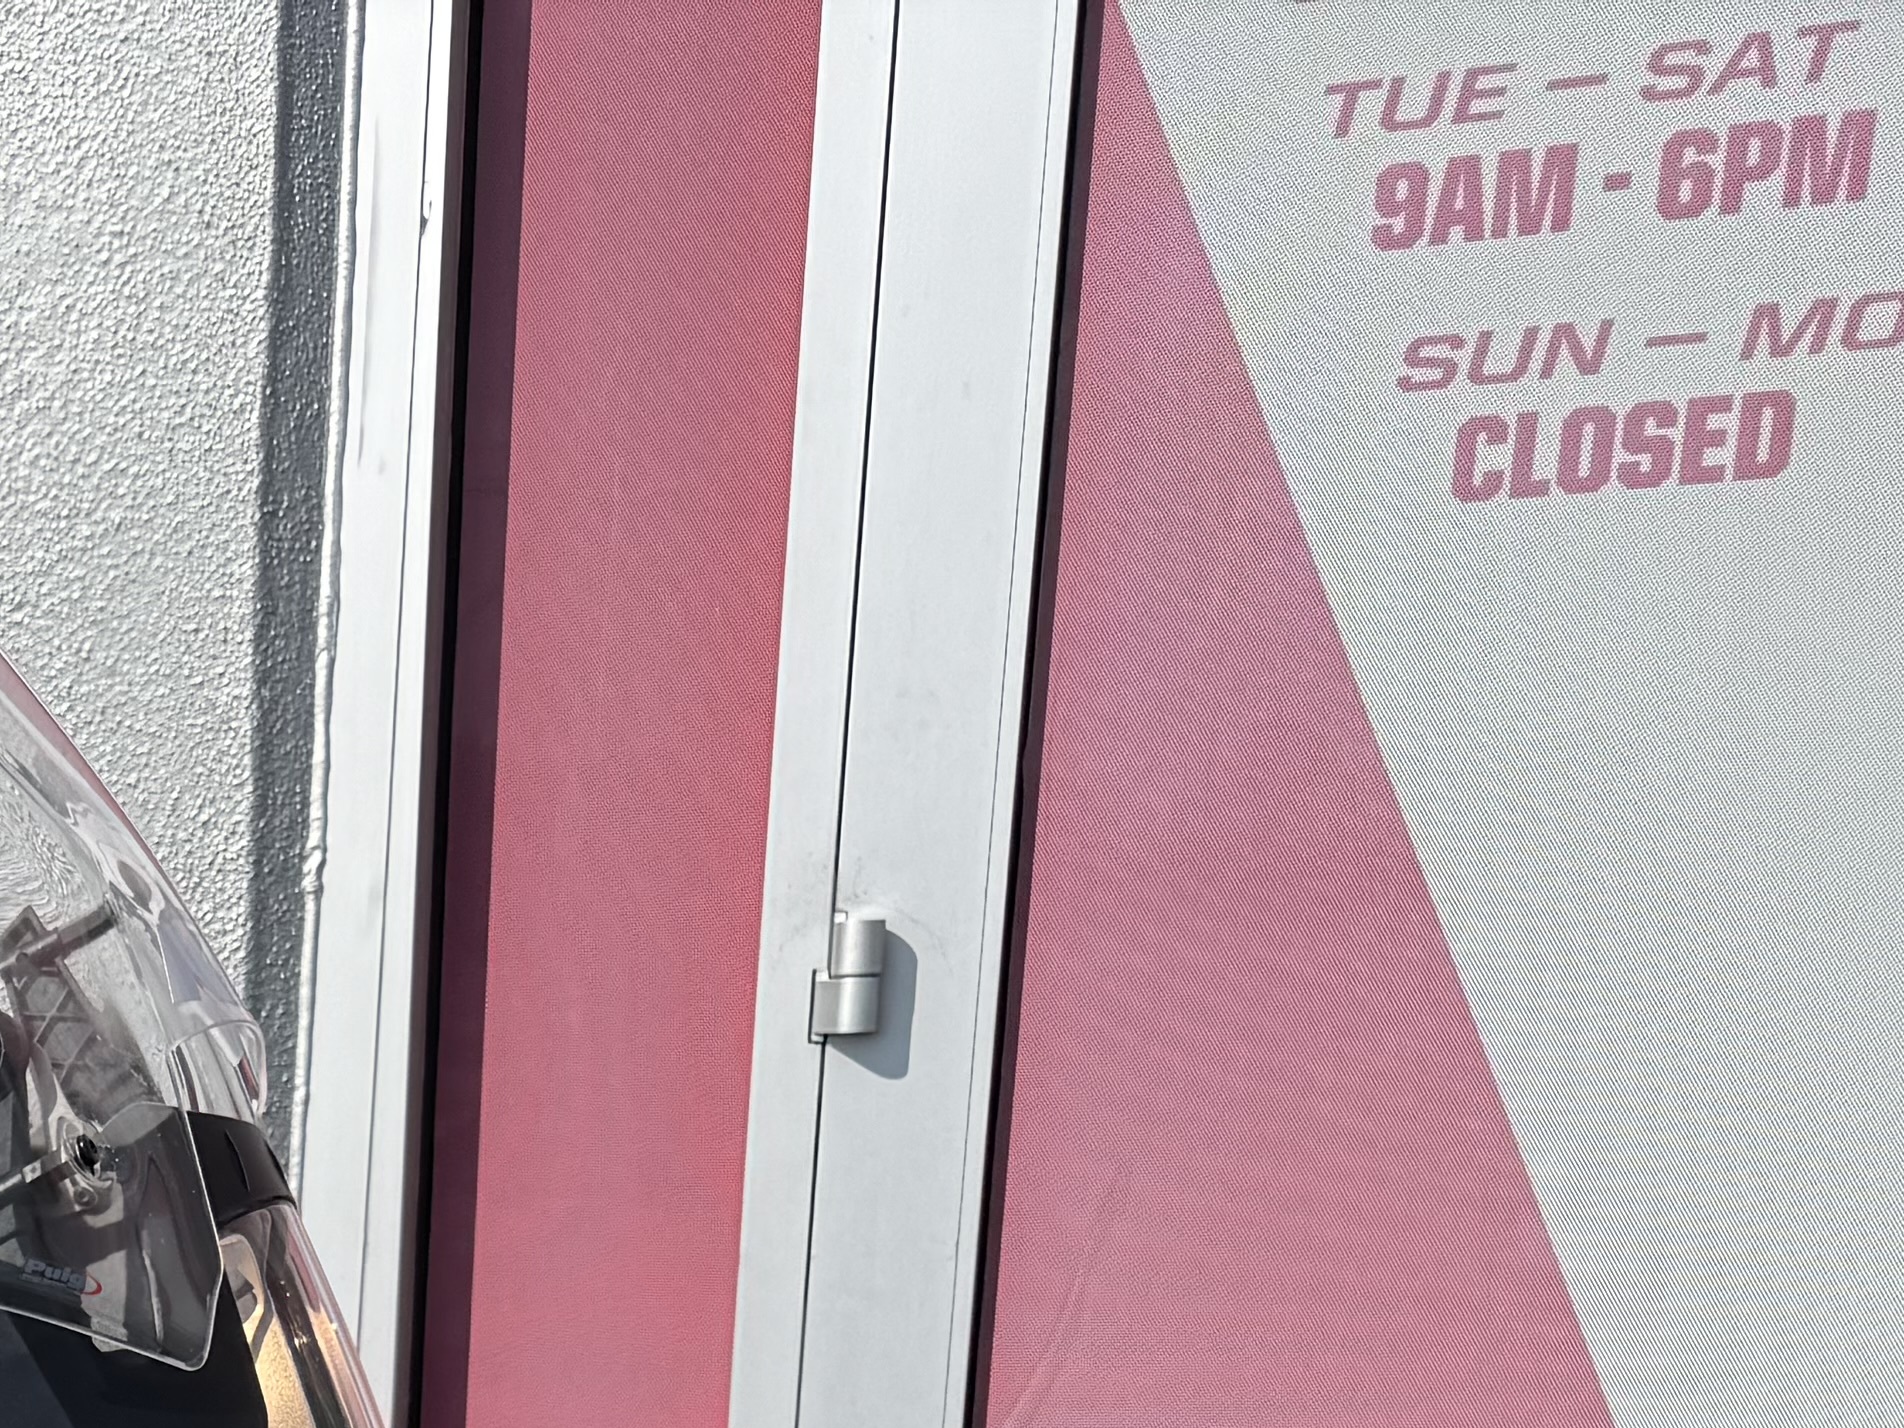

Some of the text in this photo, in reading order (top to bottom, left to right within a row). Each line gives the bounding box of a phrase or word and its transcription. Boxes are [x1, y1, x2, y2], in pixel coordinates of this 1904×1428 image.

[1326, 62, 1518, 139] TUE
[1639, 20, 1862, 103] SAT
[1371, 142, 1579, 252] 9AM
[1656, 108, 1879, 220] 6PM
[1396, 318, 1616, 393] SUN
[1451, 389, 1797, 503] CLOSED
[24, 1259, 85, 1292] Puig
